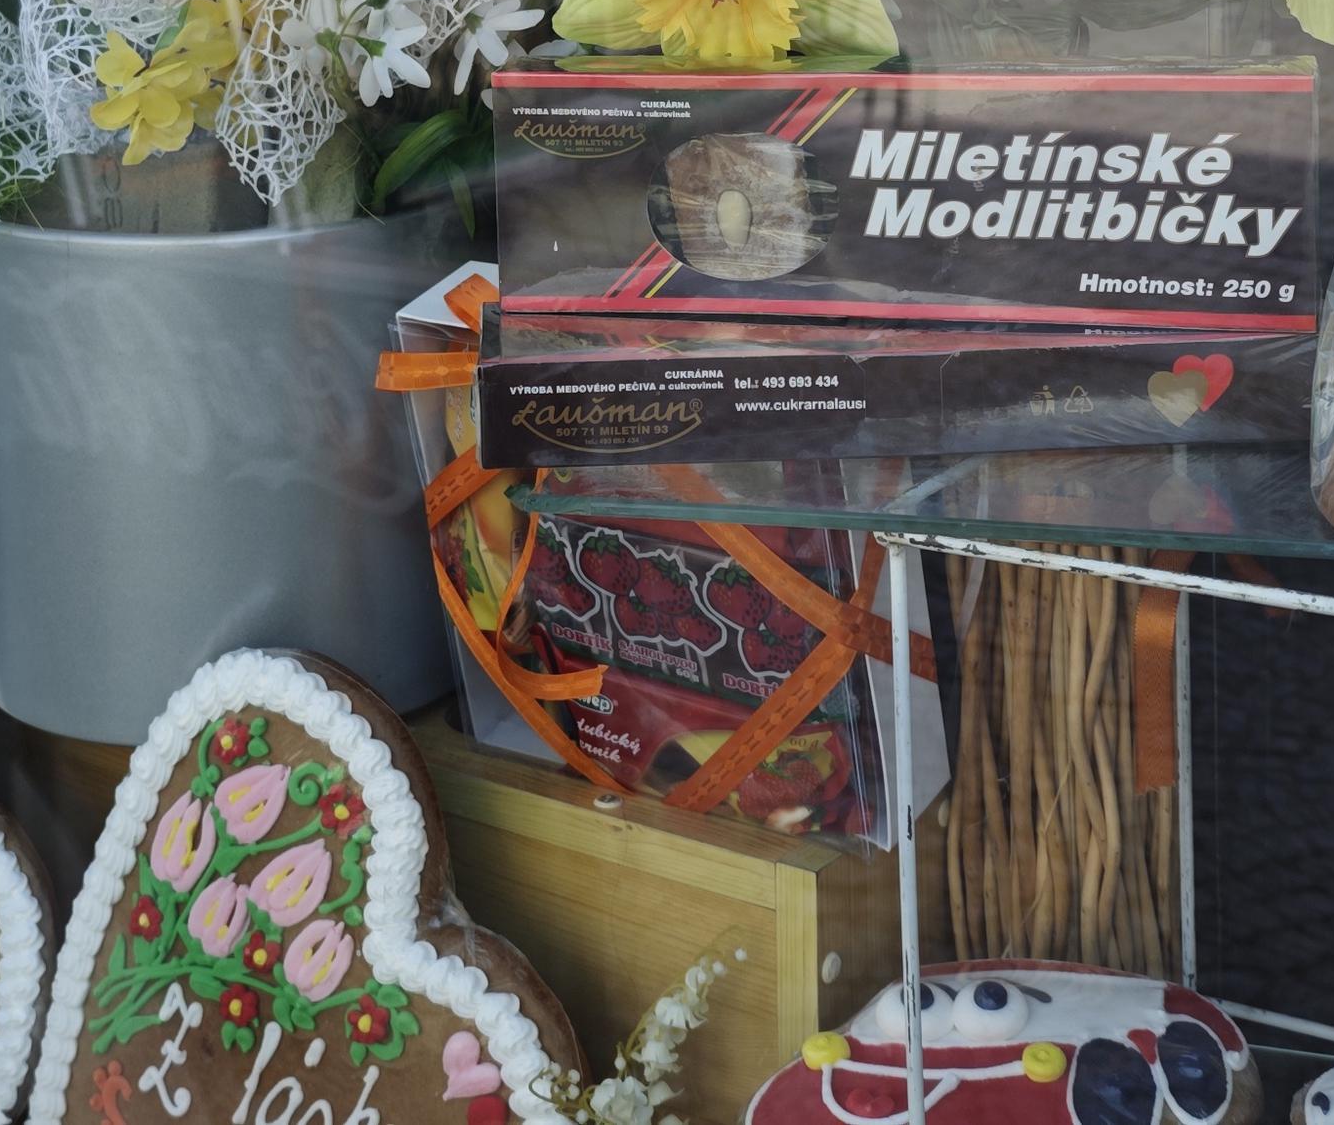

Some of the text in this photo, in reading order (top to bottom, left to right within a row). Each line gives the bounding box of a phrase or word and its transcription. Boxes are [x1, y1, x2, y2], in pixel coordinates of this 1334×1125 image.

[512, 106, 550, 116] VÝROBA
[551, 107, 601, 117] MEDOVÉHO
[602, 107, 634, 118] PEČIVA
[640, 100, 691, 109] CUKRÁRNA
[849, 128, 1241, 186] Miletínské
[864, 188, 1303, 258] Modlitbičky
[1079, 273, 1296, 303] Hmotnost: 250 g
[510, 383, 554, 395] VÝROBA
[555, 381, 616, 394] MEDOVÉHO
[618, 380, 657, 393] PEČIVA
[667, 381, 724, 391] cukrovinek
[664, 369, 724, 380] CUKRÁRNA
[762, 376, 787, 389] 493
[788, 376, 813, 388] 693
[815, 376, 840, 388] 434
[734, 399, 867, 413] www.cukrarnalaus
[555, 424, 669, 437] 507 71 MILETÍN 93
[552, 622, 614, 652] DORTÍK
[628, 642, 698, 672] JAHODOVOU
[722, 672, 779, 699] DORTÍ
[579, 738, 623, 764] erník
[231, 1021, 394, 1125] lák
